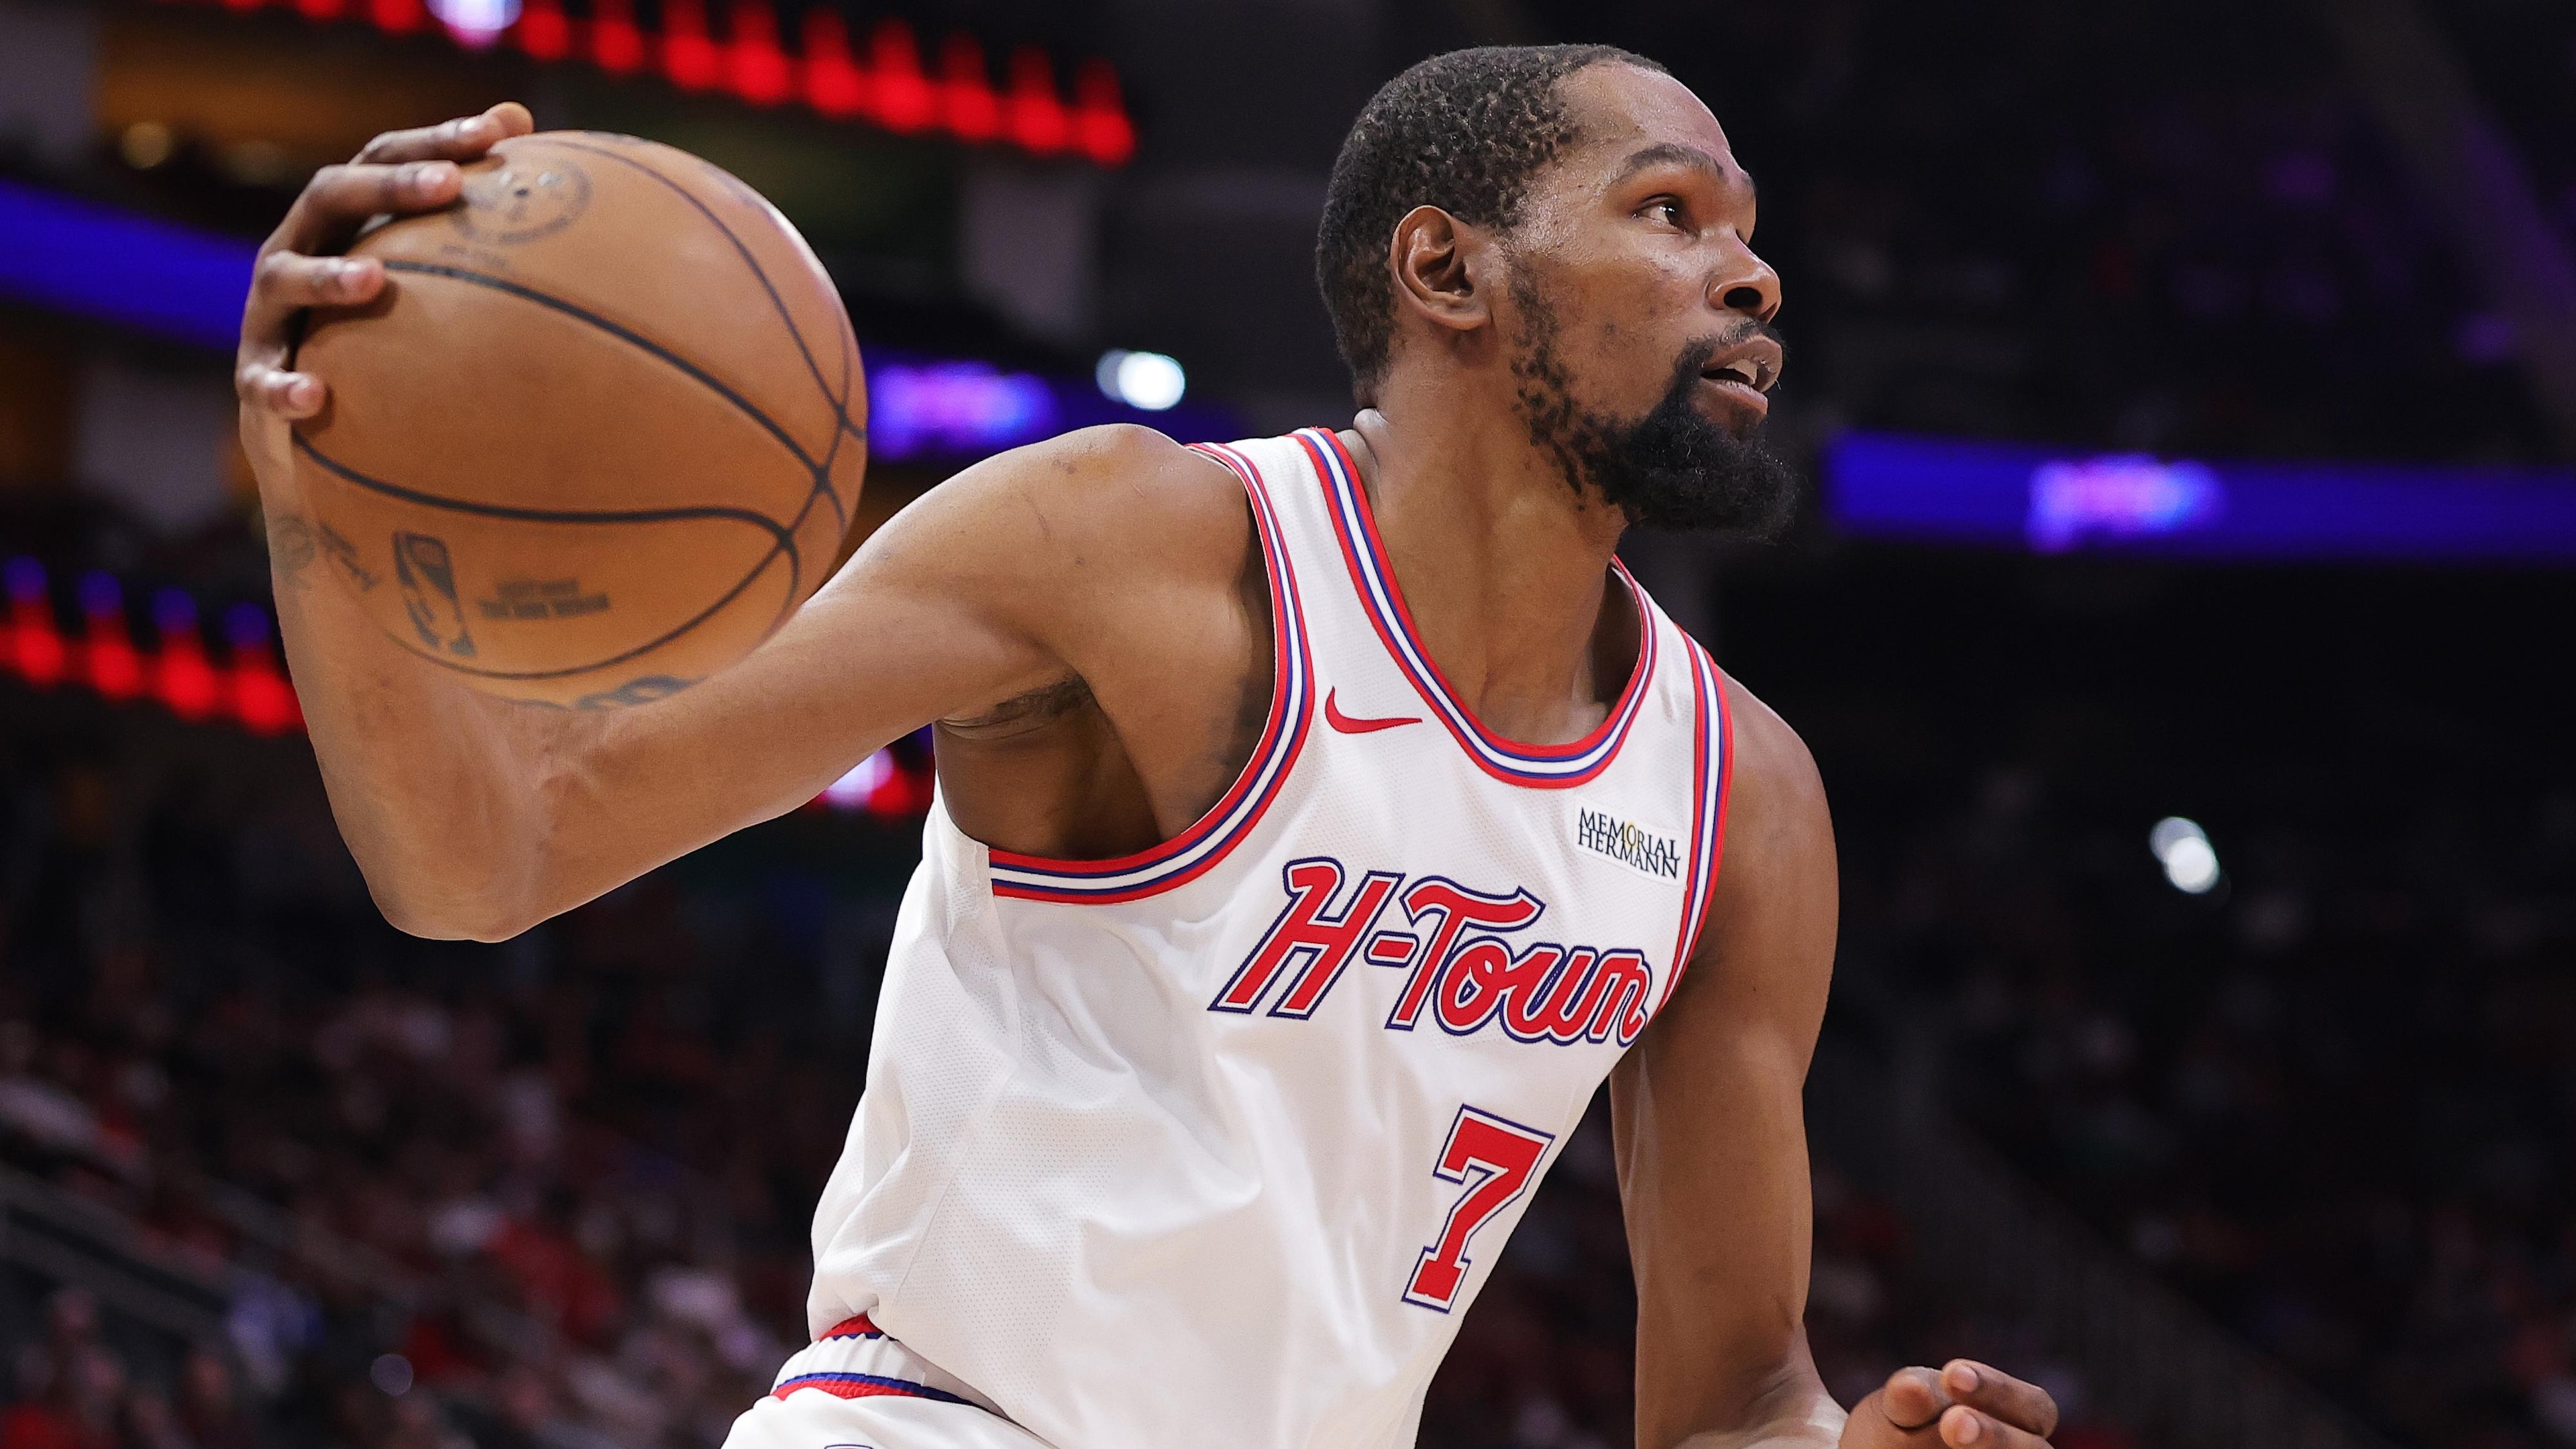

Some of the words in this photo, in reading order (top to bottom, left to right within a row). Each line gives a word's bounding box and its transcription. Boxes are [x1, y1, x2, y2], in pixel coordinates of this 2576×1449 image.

[1578, 806, 1681, 861] MEMORIAL
[1578, 823, 1678, 879] HERMANN
[1208, 856, 1652, 1047] H-Town
[1401, 1104, 1556, 1313] 7
